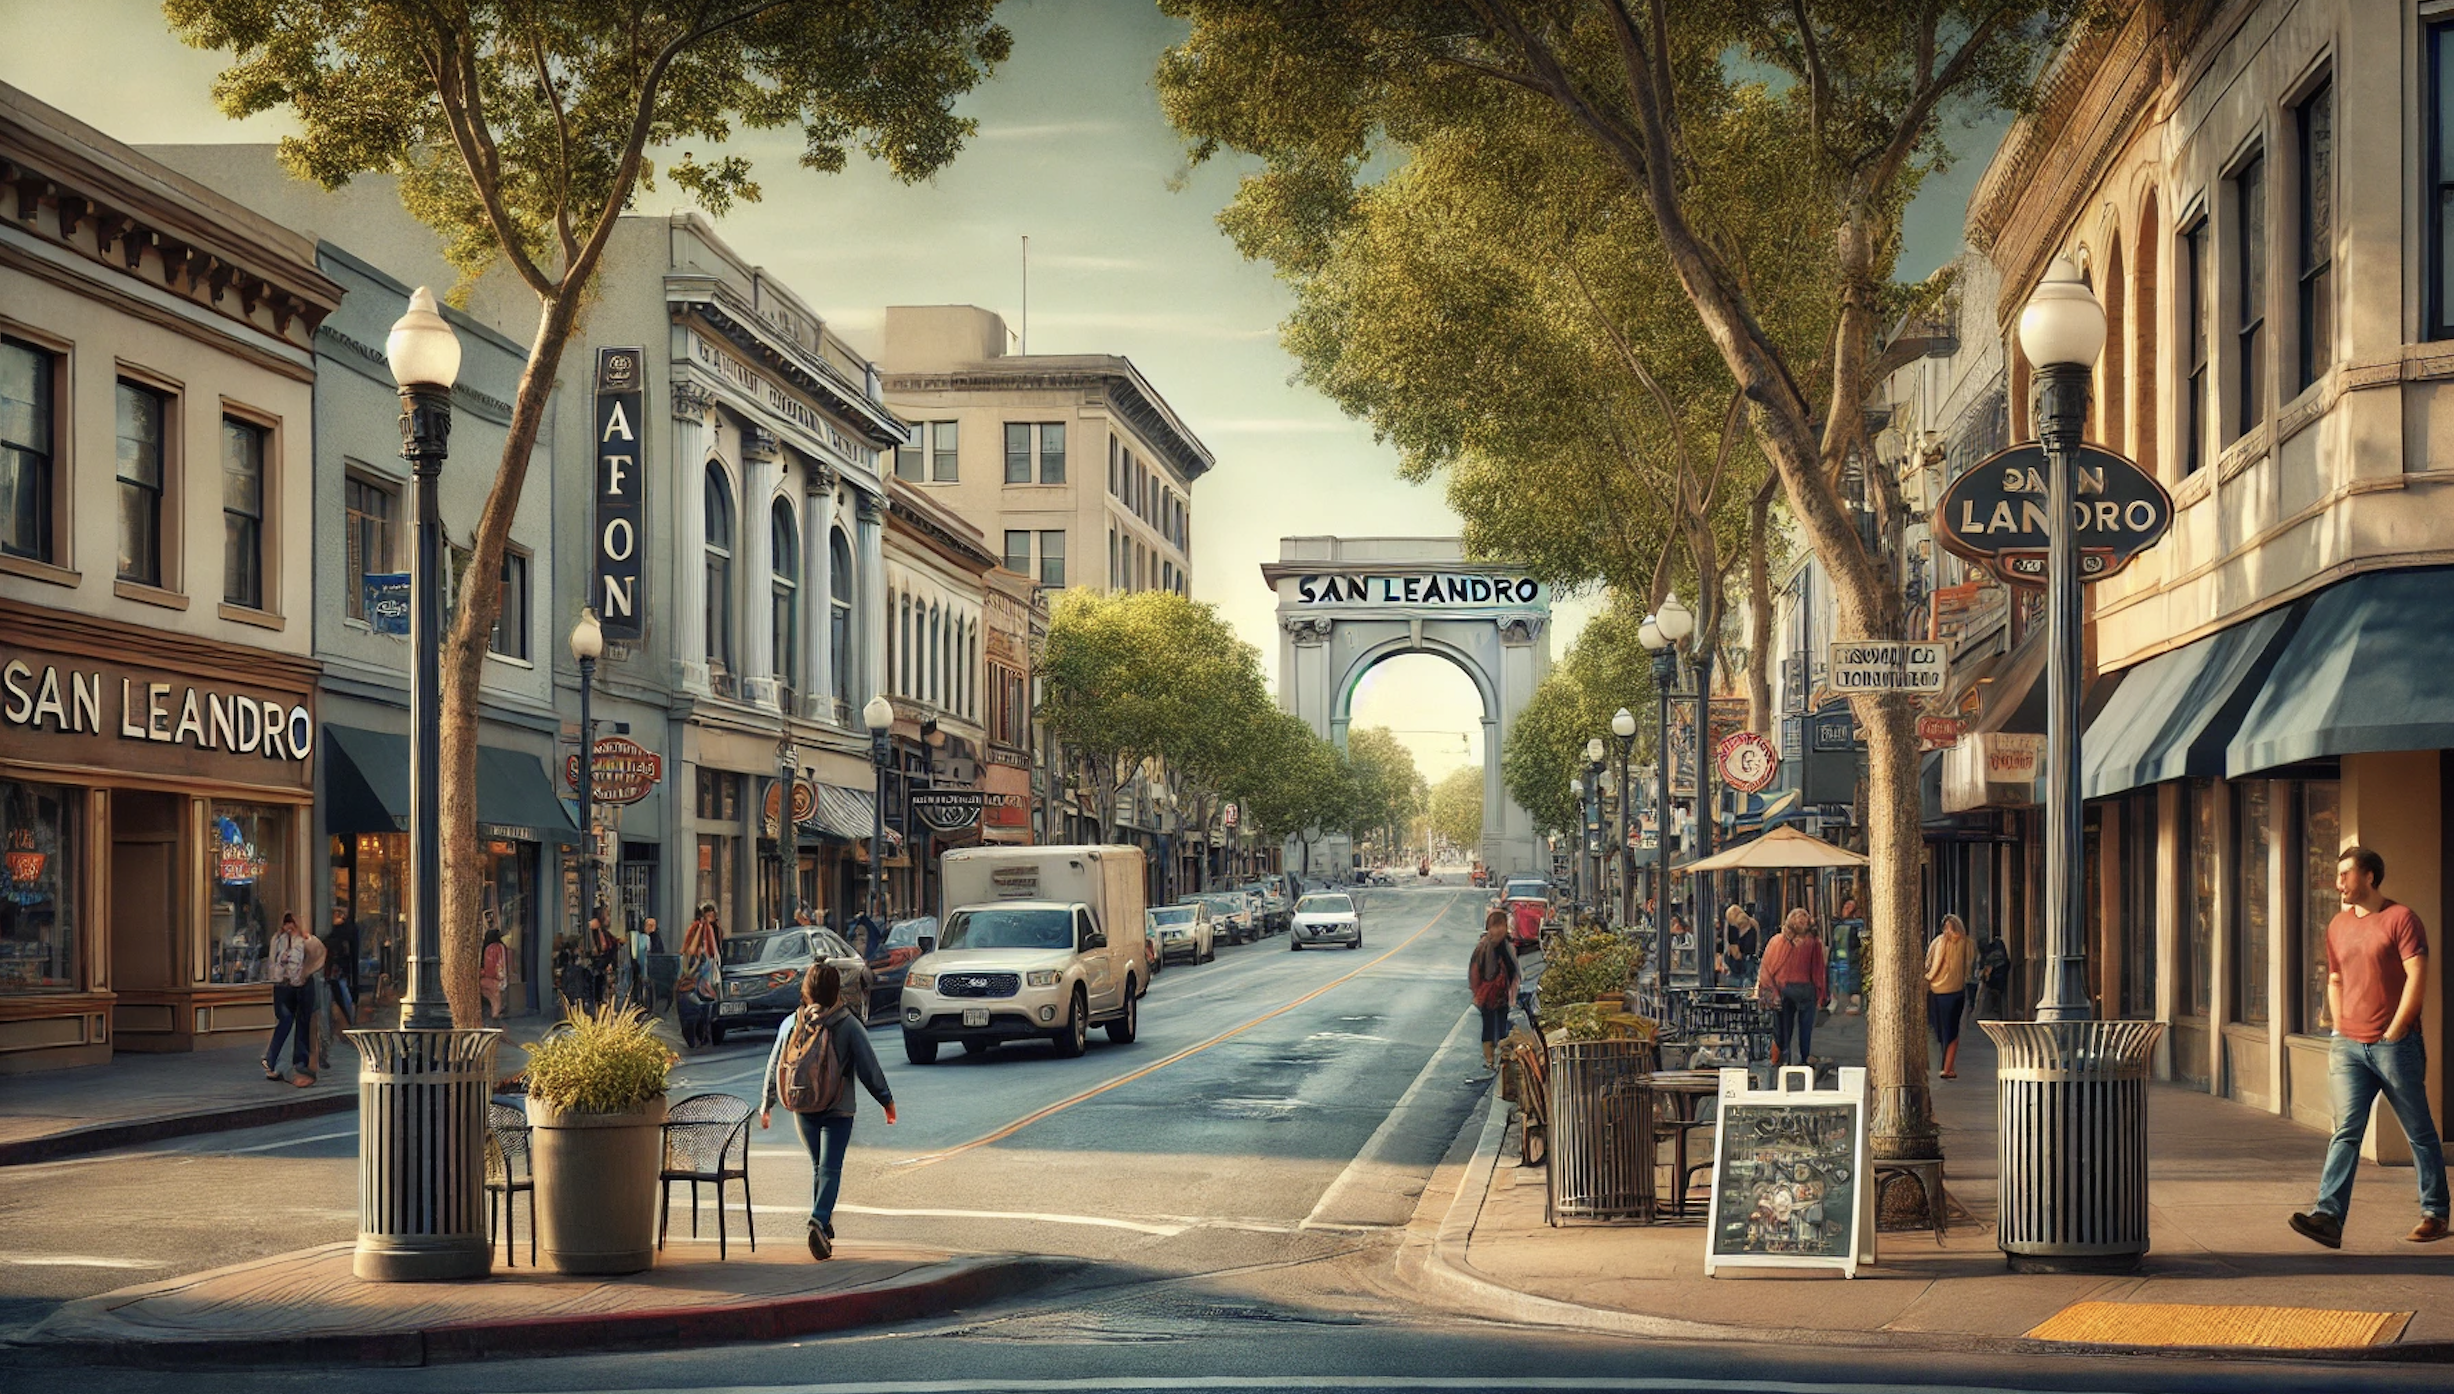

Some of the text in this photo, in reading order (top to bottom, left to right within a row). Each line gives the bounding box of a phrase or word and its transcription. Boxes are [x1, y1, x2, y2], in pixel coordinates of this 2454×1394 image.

[1297, 575, 1539, 604] SAN LEANDRO
[3, 657, 314, 762] SAN LEANDRO
